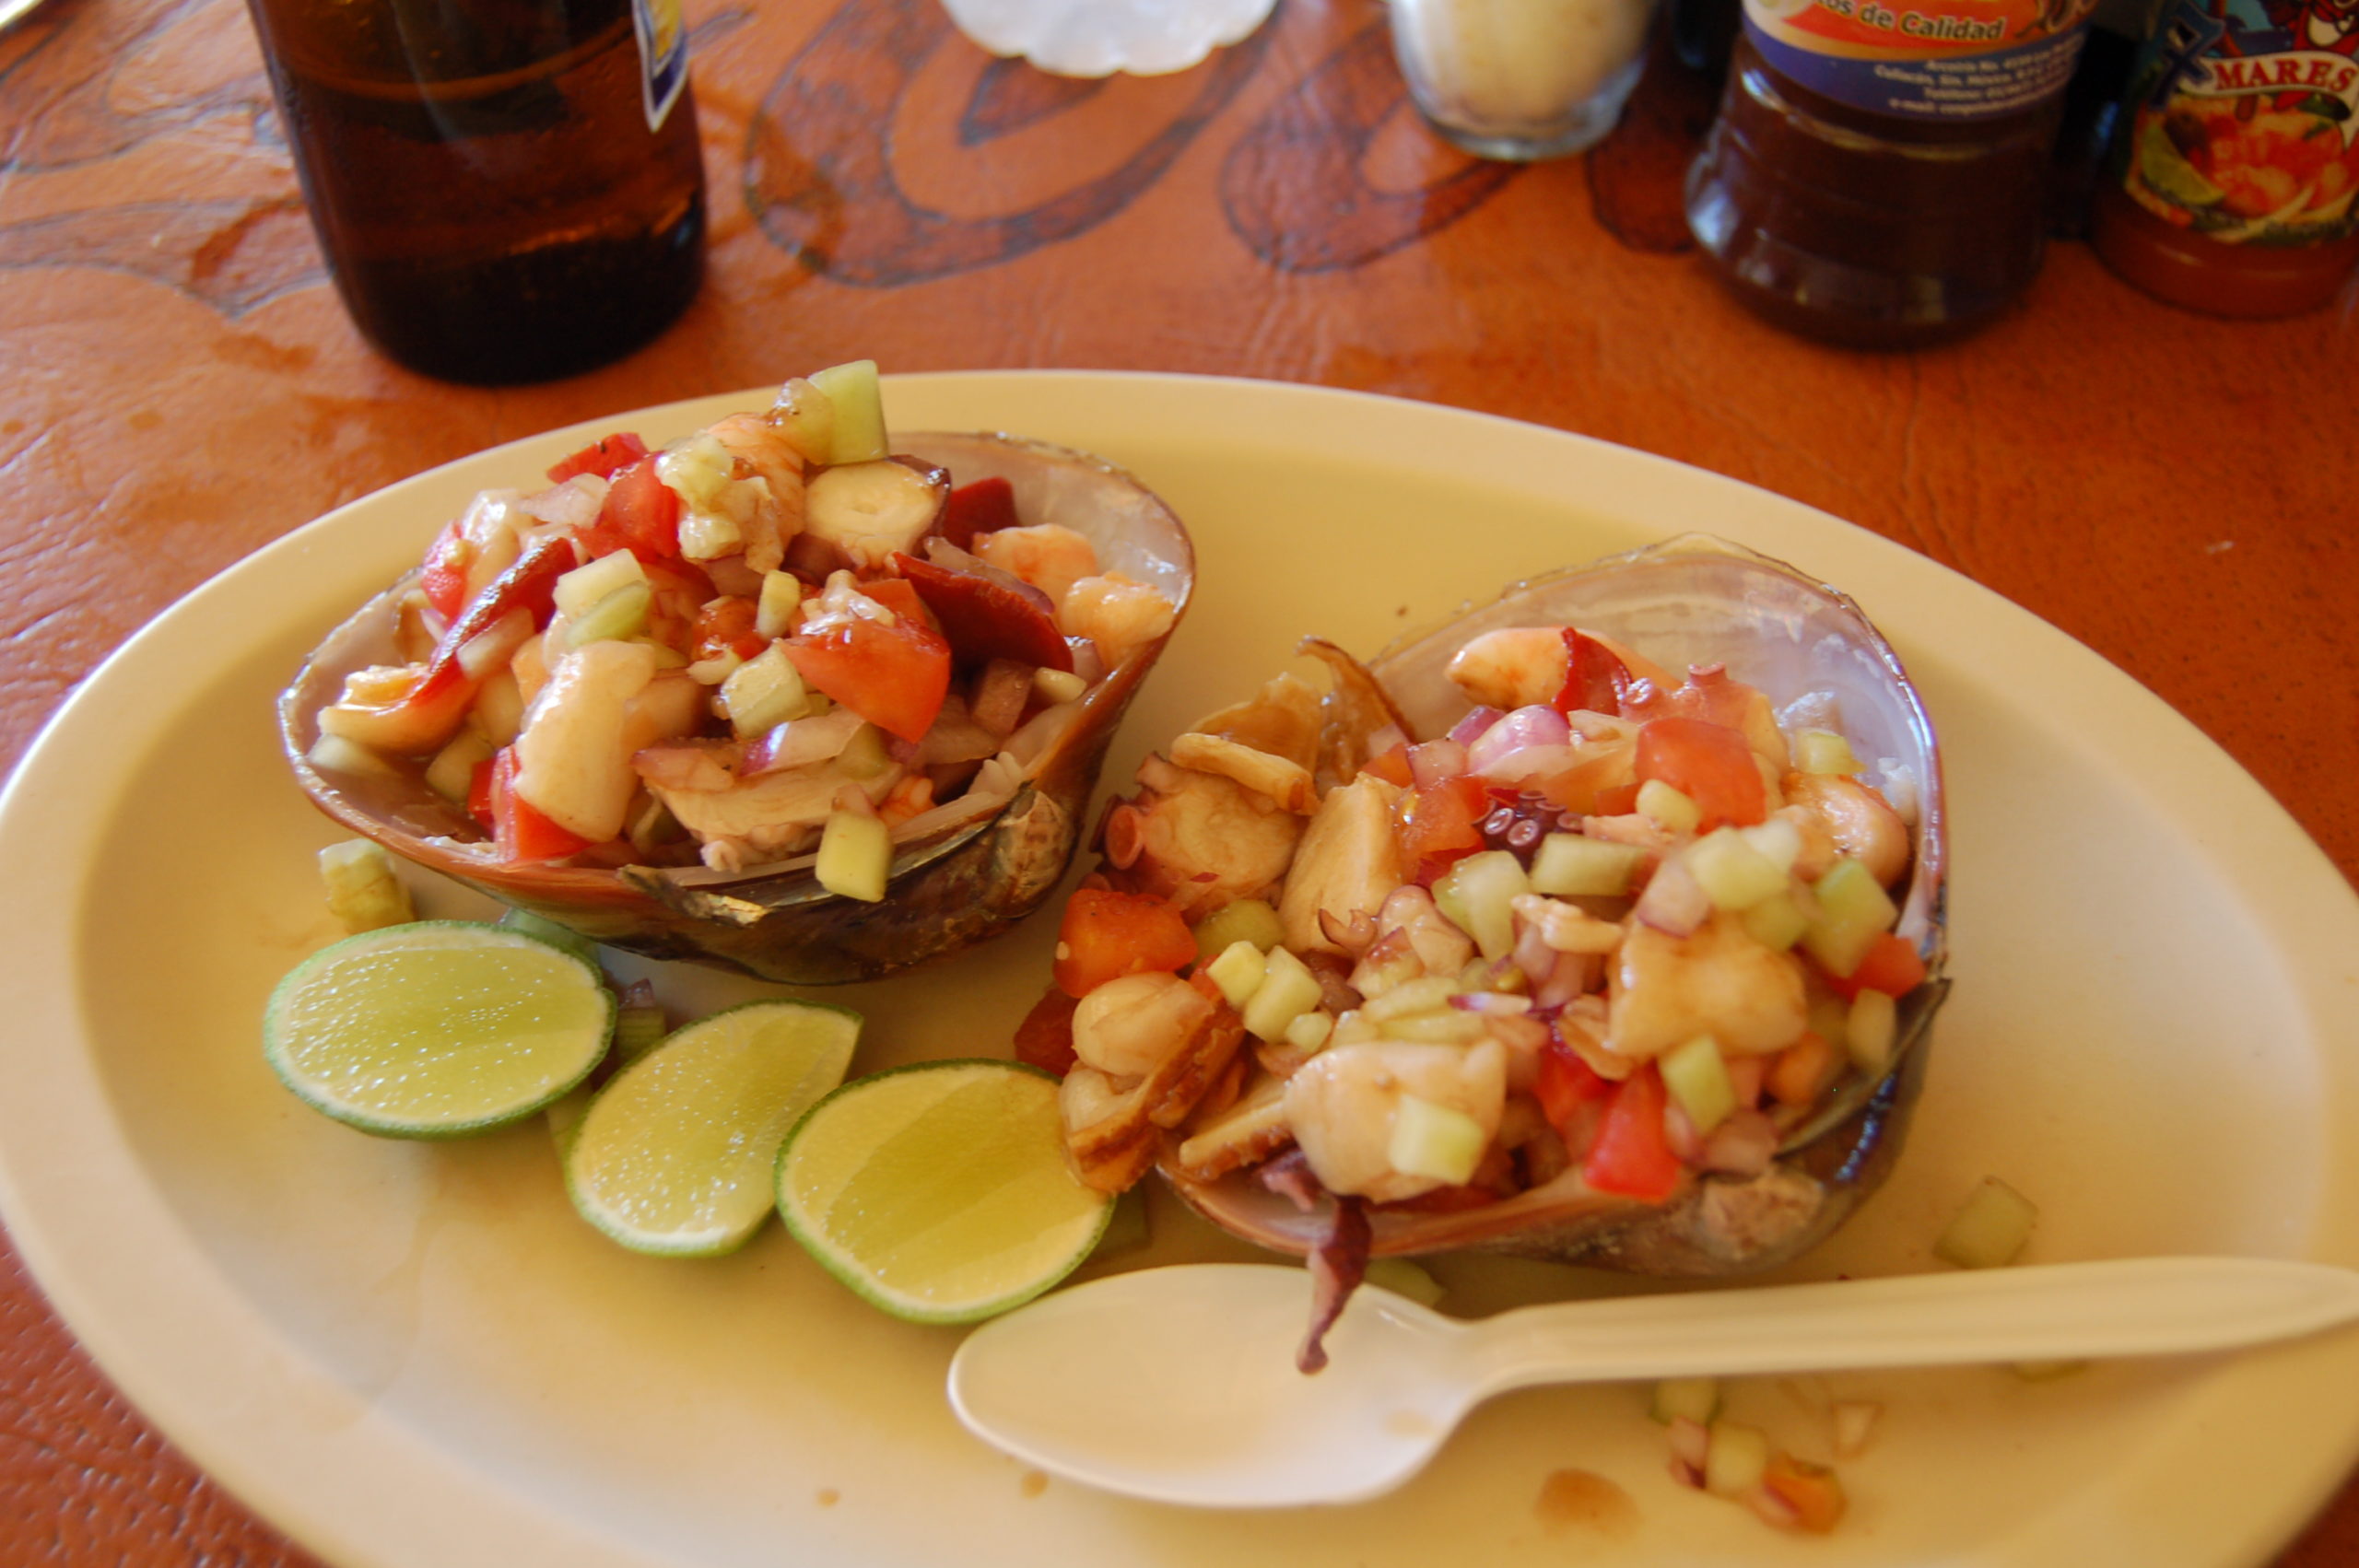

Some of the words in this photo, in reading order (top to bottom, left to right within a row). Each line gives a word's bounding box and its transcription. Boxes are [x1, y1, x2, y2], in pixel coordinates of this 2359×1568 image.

[1859, 3, 1894, 30] de
[1900, 12, 2006, 41] Calidad
[2213, 57, 2358, 94] MARES
